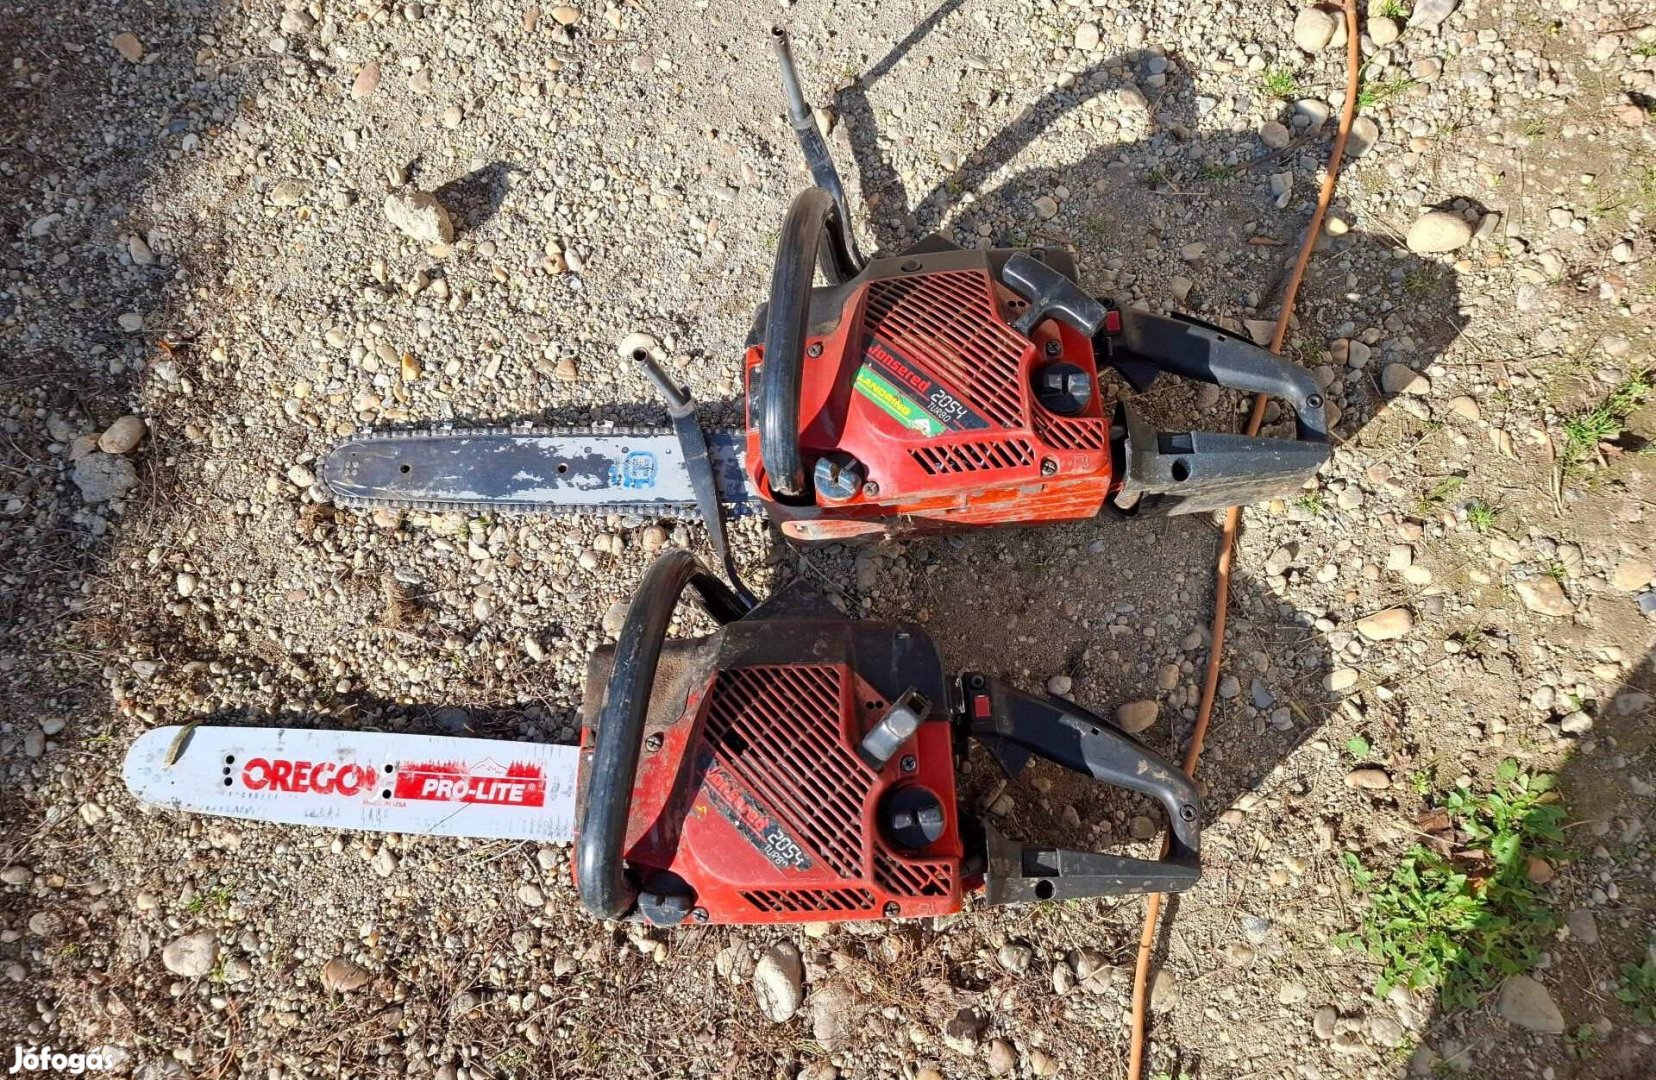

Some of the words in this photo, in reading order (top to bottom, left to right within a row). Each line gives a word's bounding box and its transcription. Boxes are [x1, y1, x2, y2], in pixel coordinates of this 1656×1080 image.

[867, 344, 931, 393] Jonsered
[930, 389, 968, 420] 2054
[926, 402, 951, 422] TURBO
[767, 828, 804, 865] 2054
